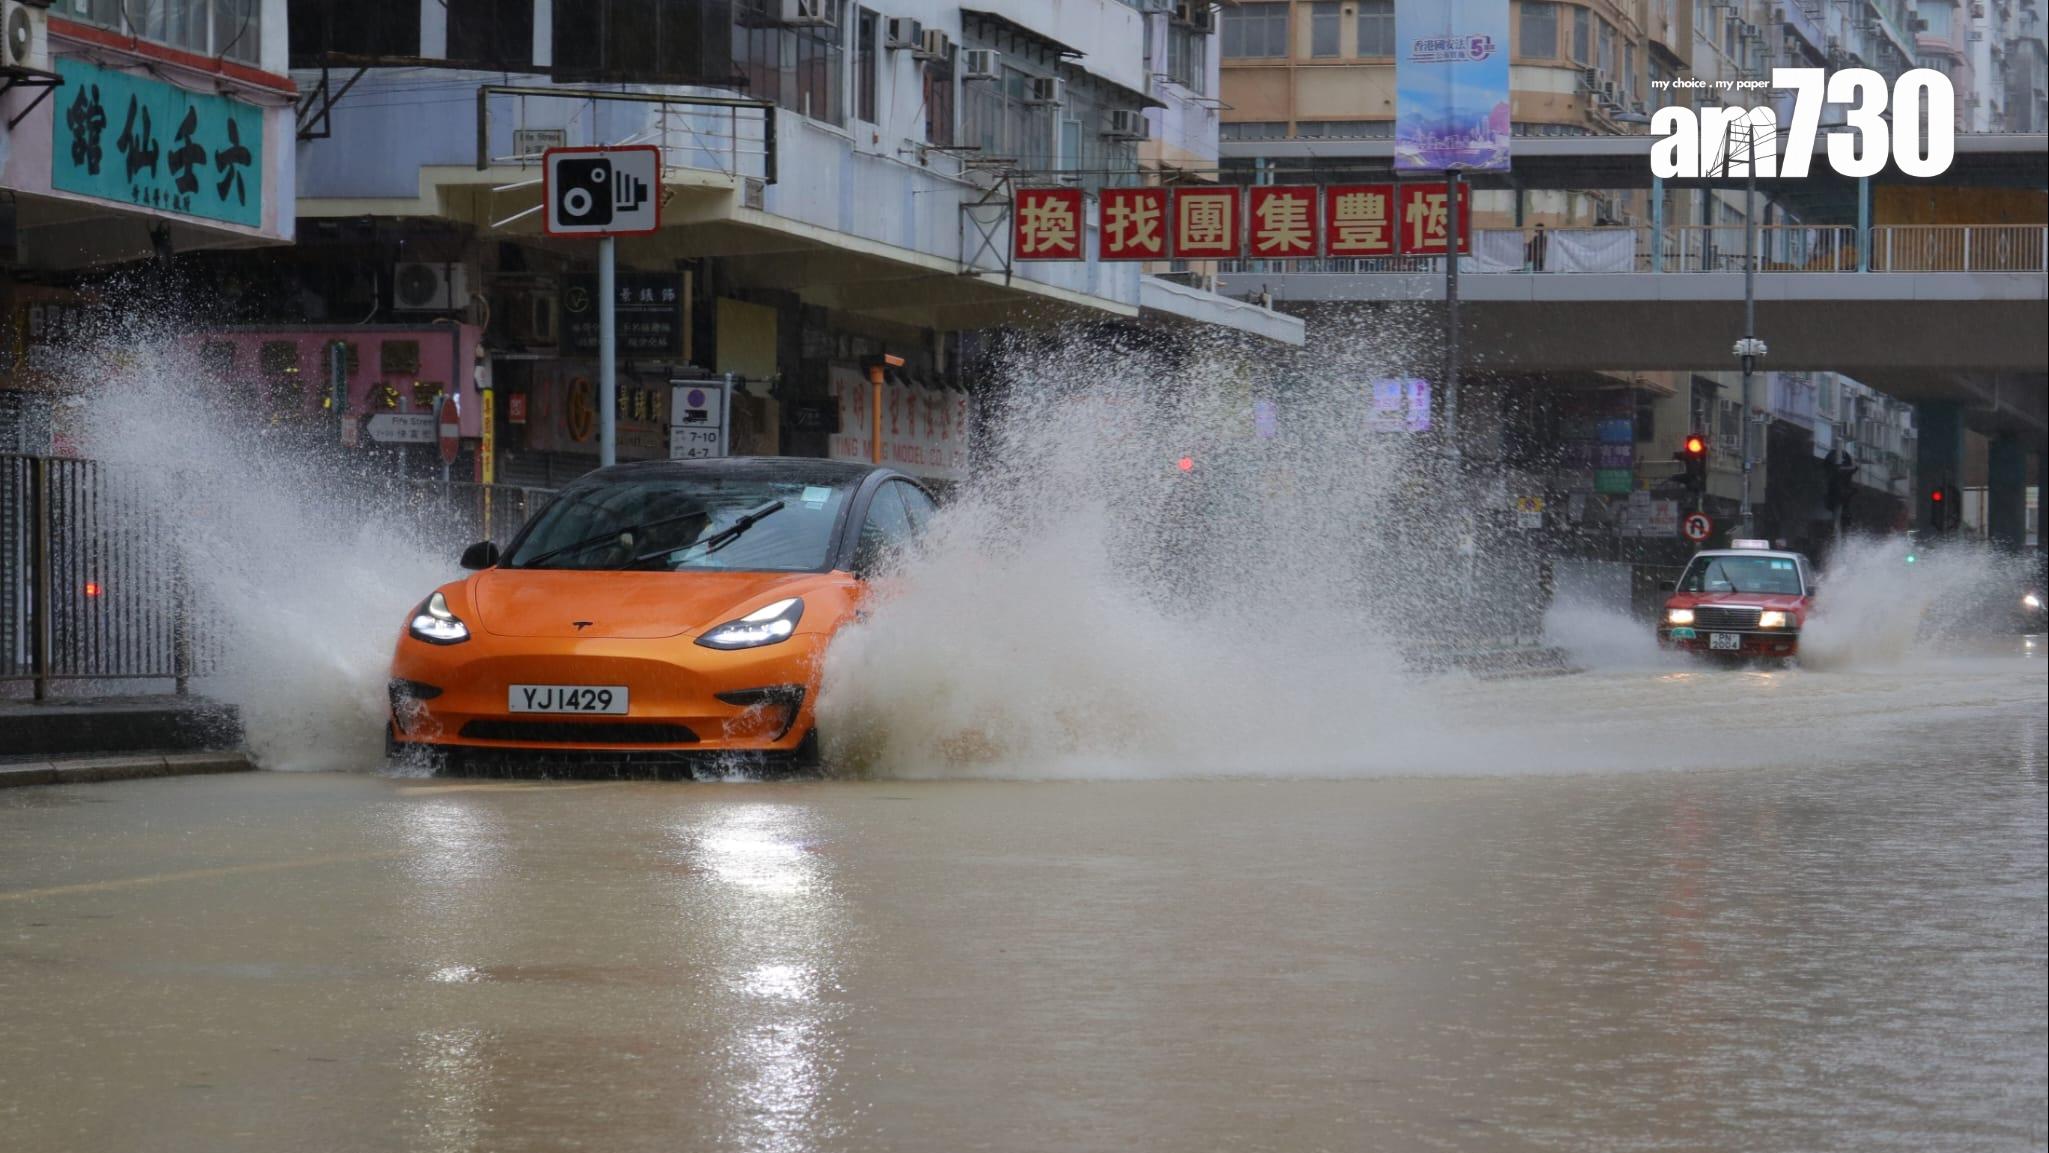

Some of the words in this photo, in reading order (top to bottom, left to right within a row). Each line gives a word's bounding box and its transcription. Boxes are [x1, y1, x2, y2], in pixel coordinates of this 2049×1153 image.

[688, 431, 717, 442] 7-10
[687, 447, 709, 458] 4-7
[863, 439, 889, 460] MG
